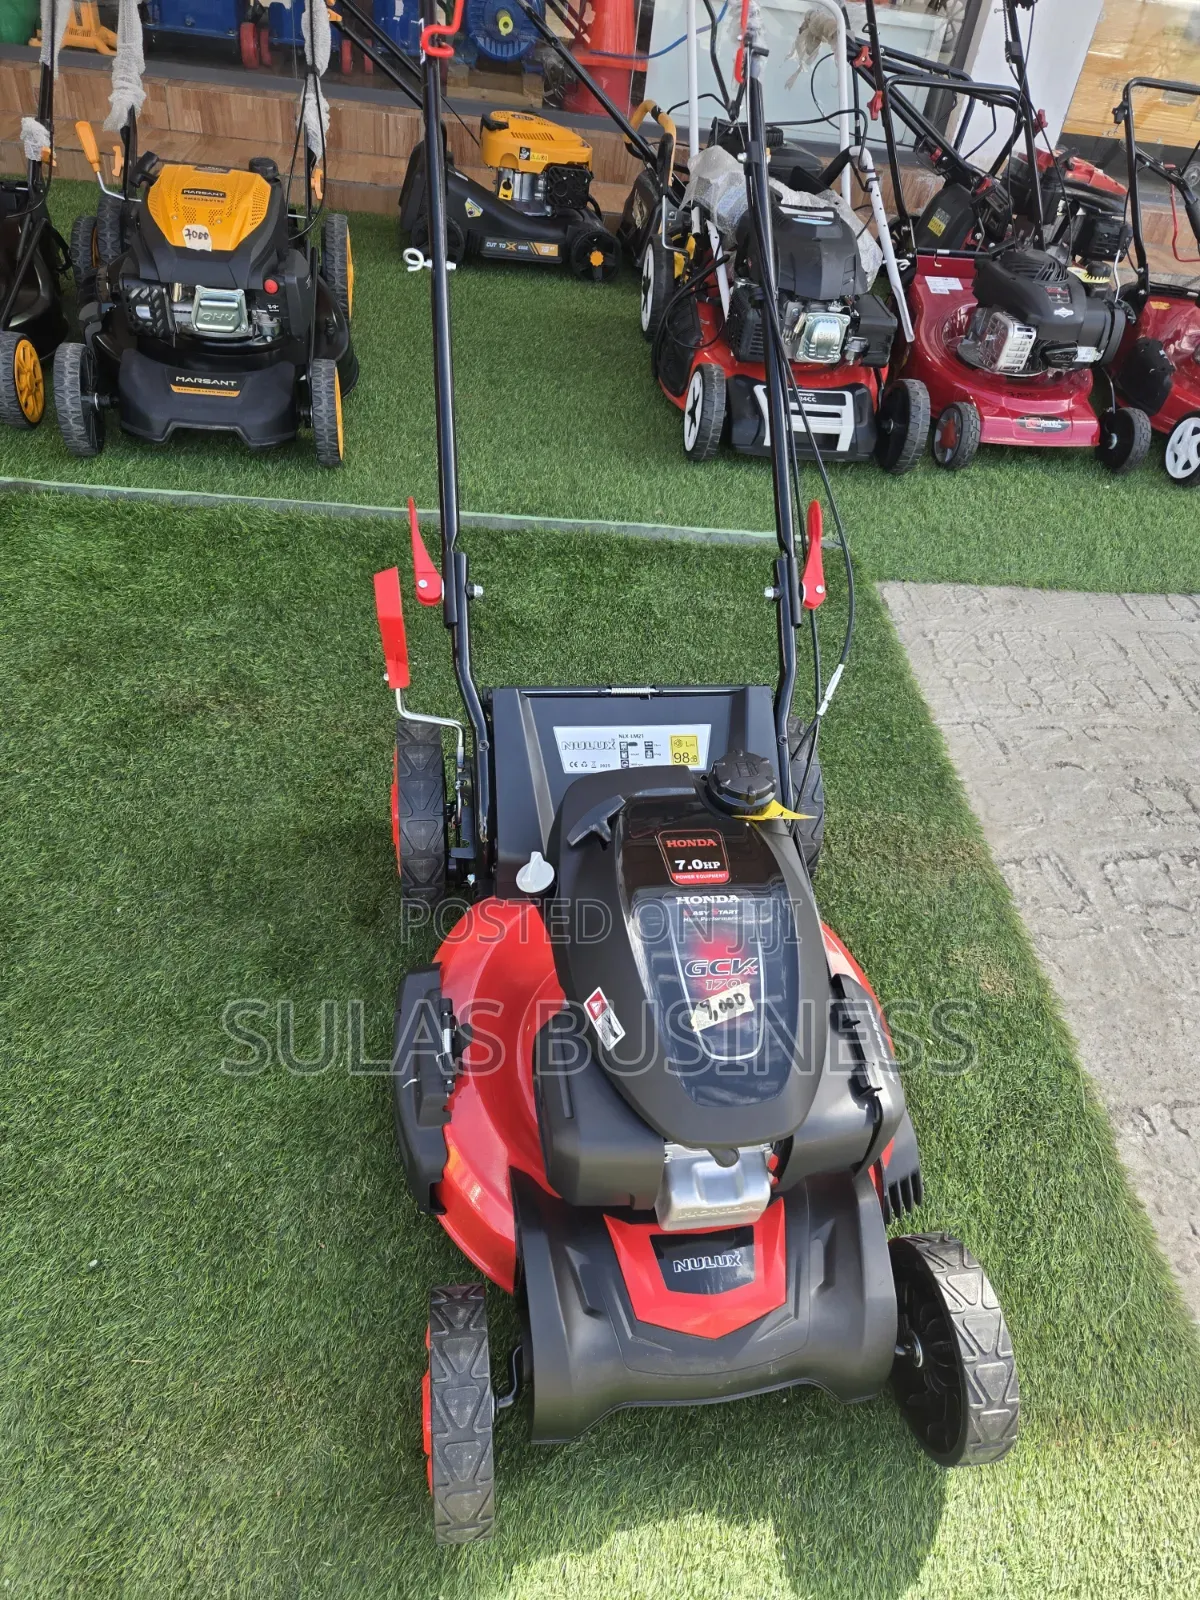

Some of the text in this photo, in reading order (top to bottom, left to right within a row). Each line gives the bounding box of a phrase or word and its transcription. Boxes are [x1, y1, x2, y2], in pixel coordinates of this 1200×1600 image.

[183, 189, 225, 198] MARSANT
[175, 376, 237, 387] MARSANT
[665, 838, 717, 848] HONDA
[675, 894, 740, 905] HONDA
[673, 1251, 743, 1273] NULUX
